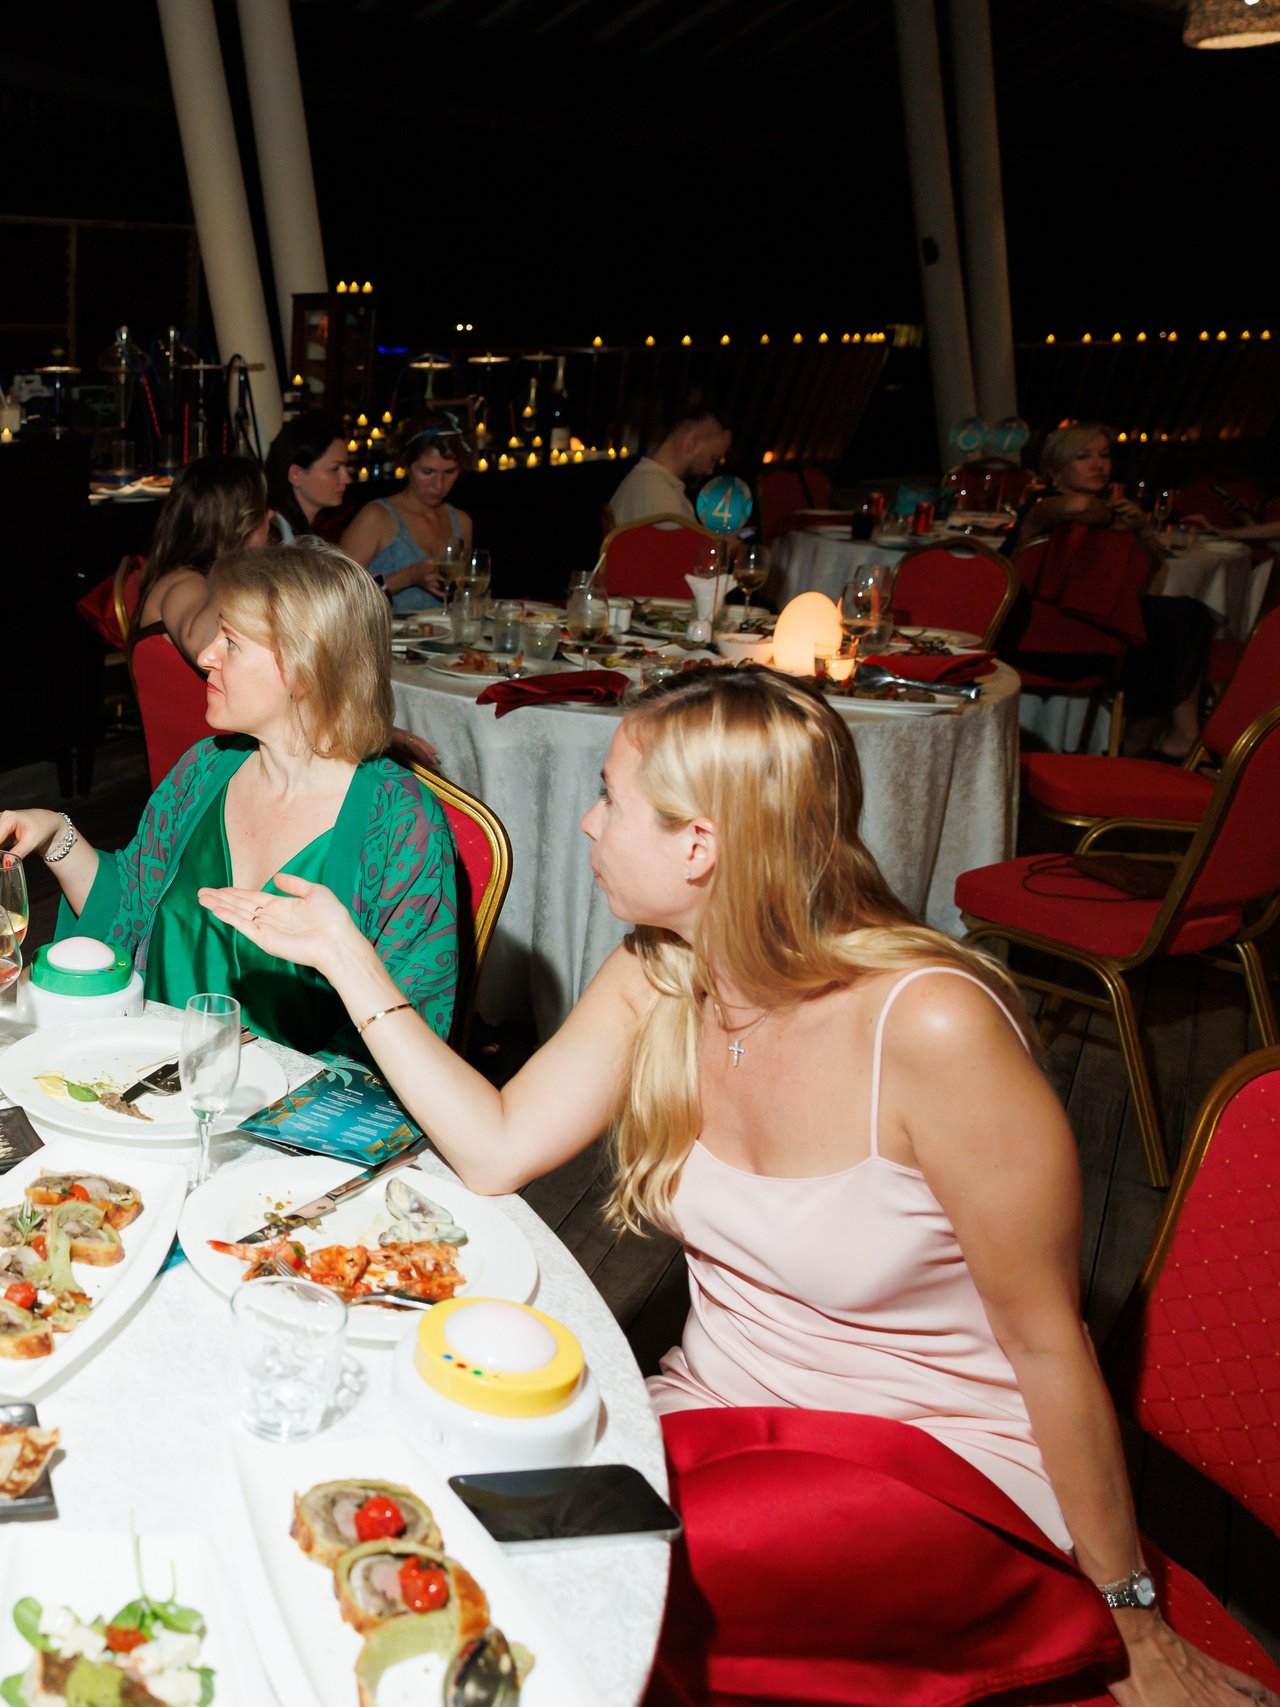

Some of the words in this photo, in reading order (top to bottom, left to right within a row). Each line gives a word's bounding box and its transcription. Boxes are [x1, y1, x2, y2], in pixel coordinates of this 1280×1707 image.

[957, 422, 981, 451] 6
[1003, 421, 1018, 450] 7
[712, 486, 732, 527] 4
